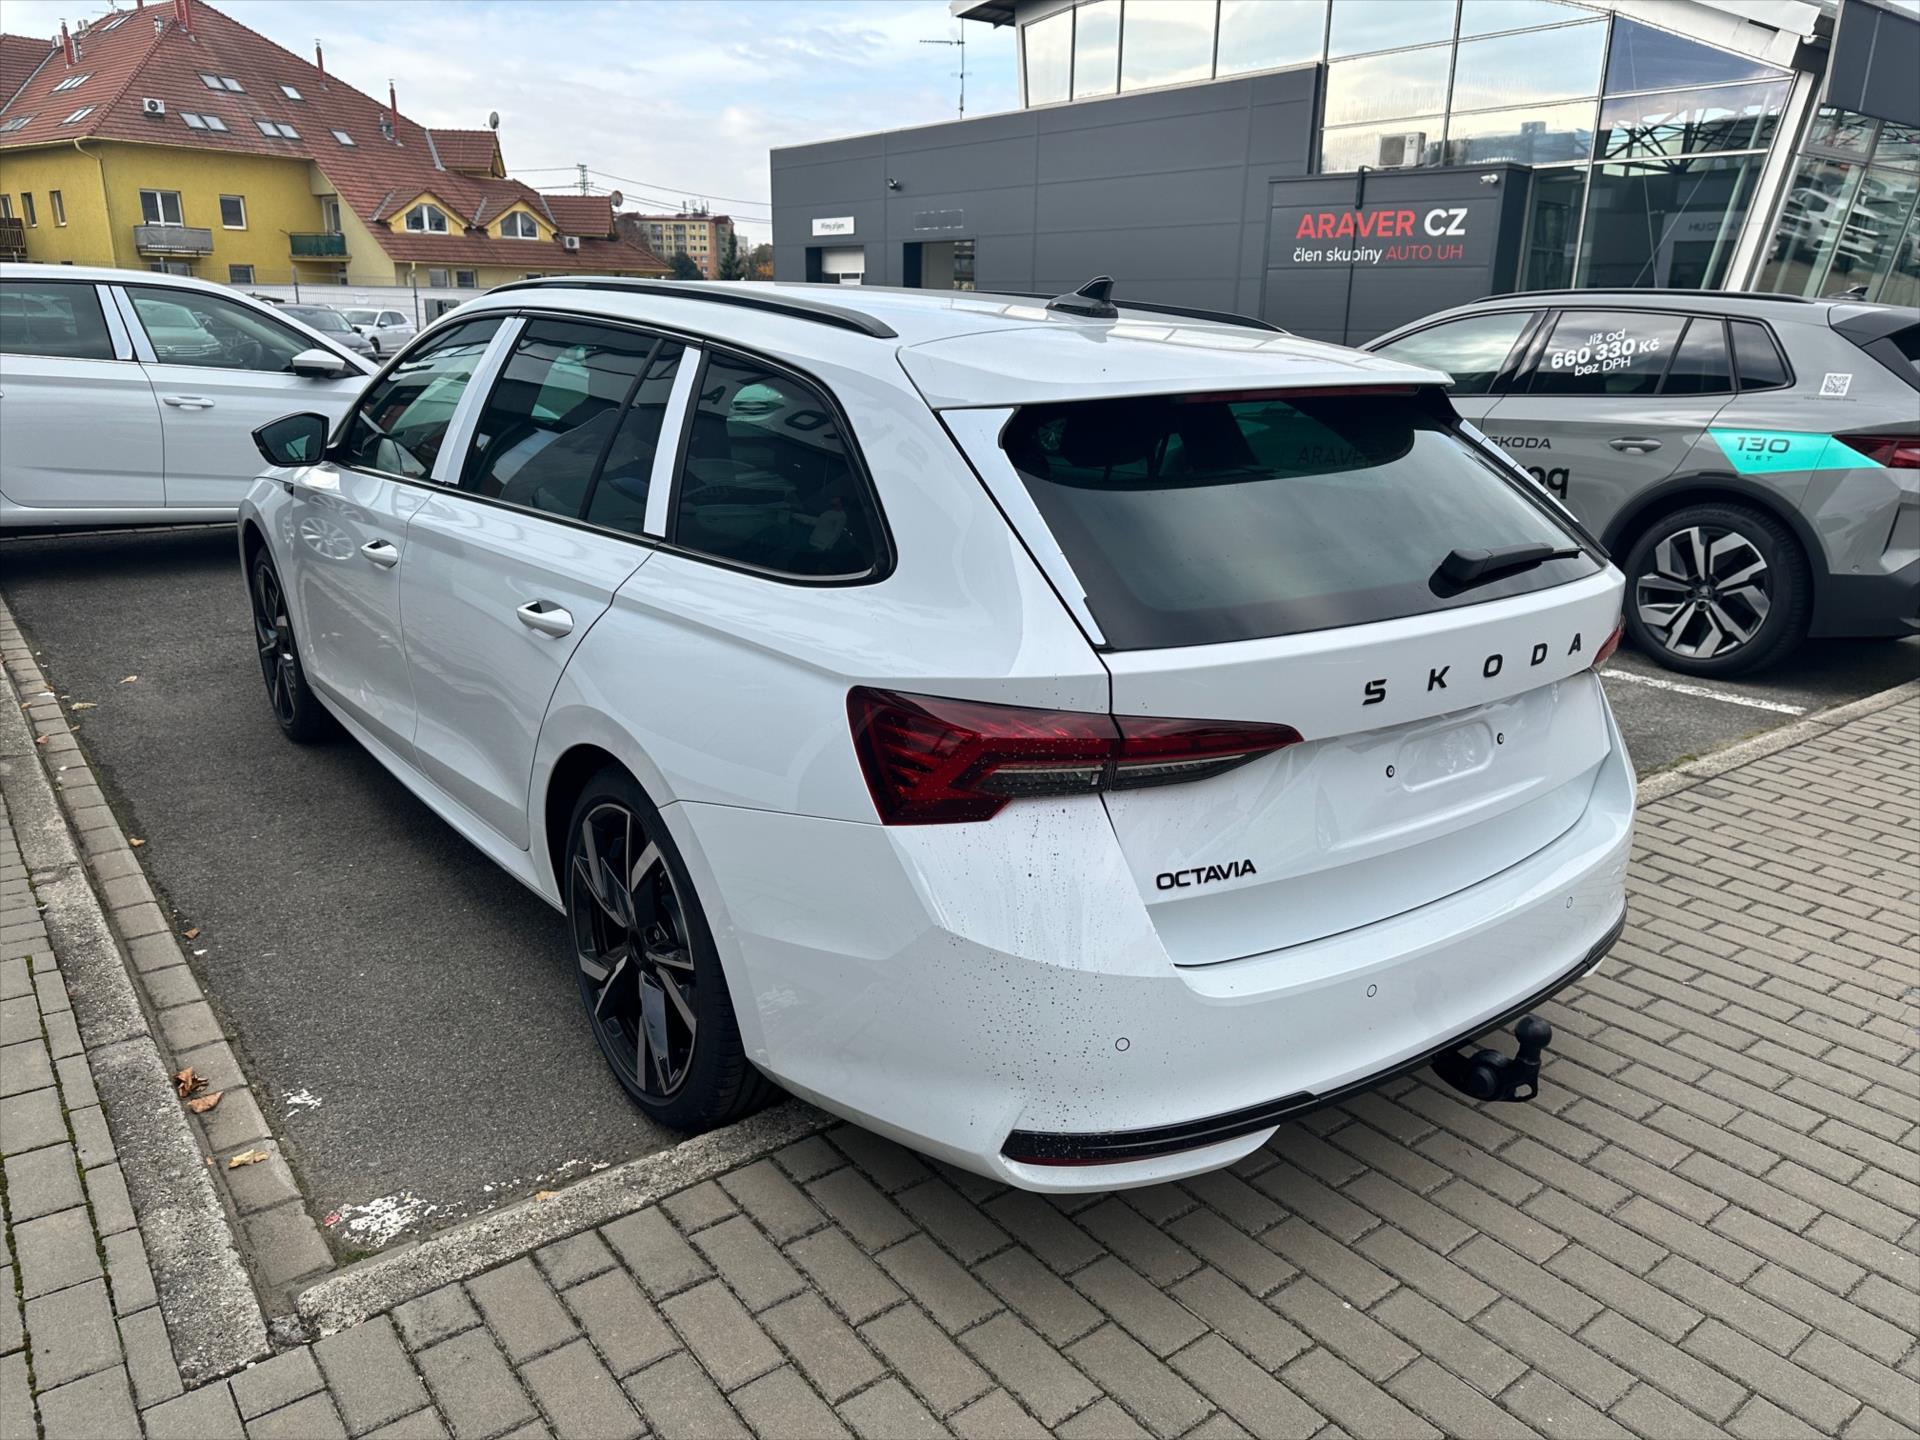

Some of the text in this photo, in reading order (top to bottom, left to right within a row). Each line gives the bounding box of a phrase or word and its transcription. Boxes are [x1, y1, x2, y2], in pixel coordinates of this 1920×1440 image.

[1296, 208, 1468, 239] ARAVER CZ
[1293, 244, 1463, 264] člen skupiny AUTO UH
[1585, 328, 1625, 346] Již od
[1551, 337, 1660, 369] 660 330 Kč
[1575, 356, 1631, 376] bez DPH
[1737, 437, 1790, 453] 130
[1156, 858, 1257, 890] OCTAVIA
